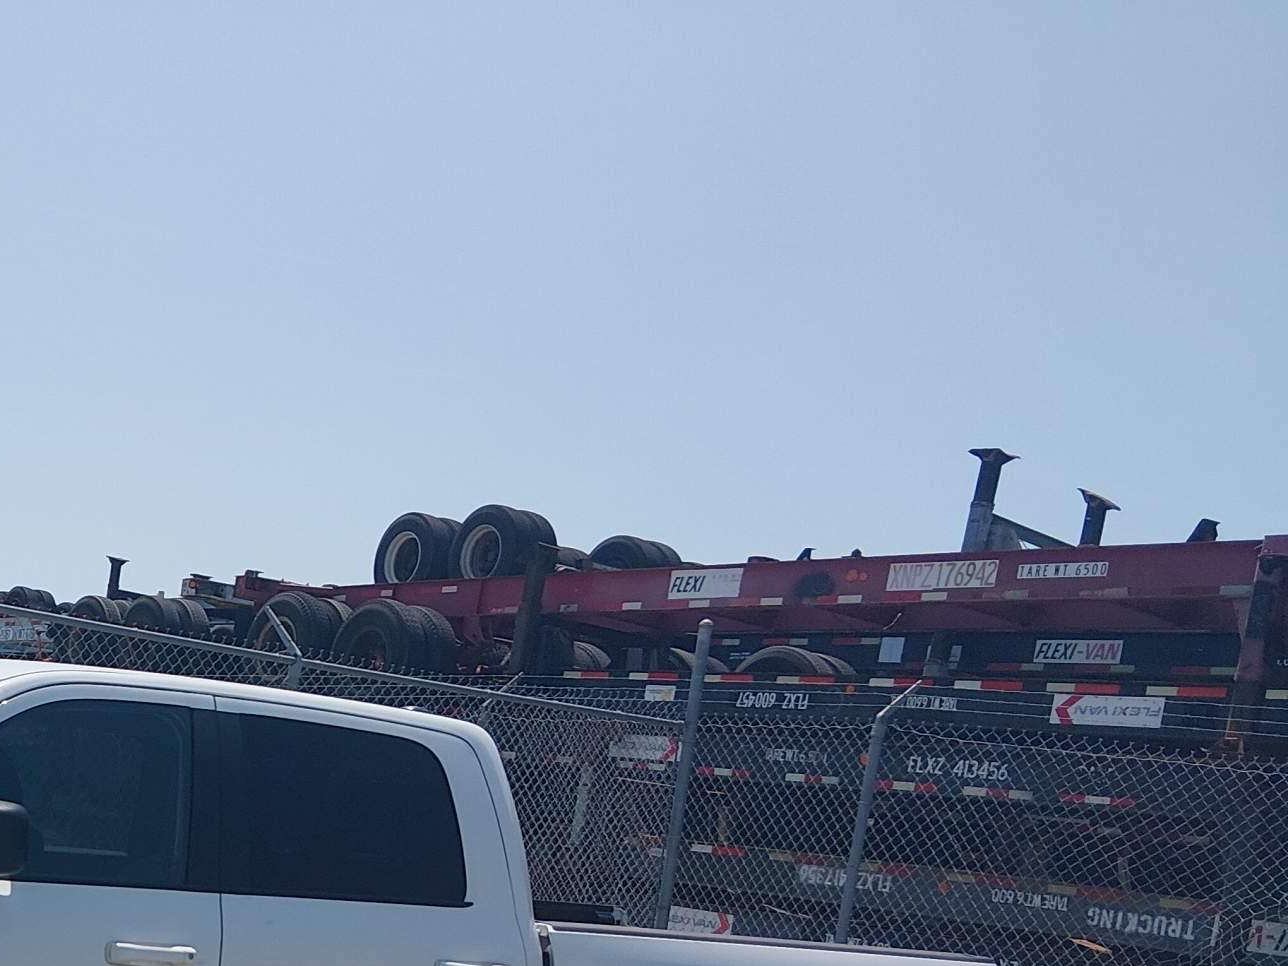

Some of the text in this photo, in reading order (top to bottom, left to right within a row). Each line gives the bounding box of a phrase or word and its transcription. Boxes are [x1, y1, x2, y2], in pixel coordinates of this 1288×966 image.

[1020, 565, 1049, 577] TARE
[1075, 563, 1107, 576] 6500
[670, 575, 706, 593] FLEXI
[1035, 642, 1121, 660] FLEXI-VAN
[782, 693, 809, 710] FLXZ
[1112, 706, 1162, 718] FLEXI
[907, 756, 1009, 781] FLXZ 413456
[1087, 907, 1195, 940] TRUCKING
